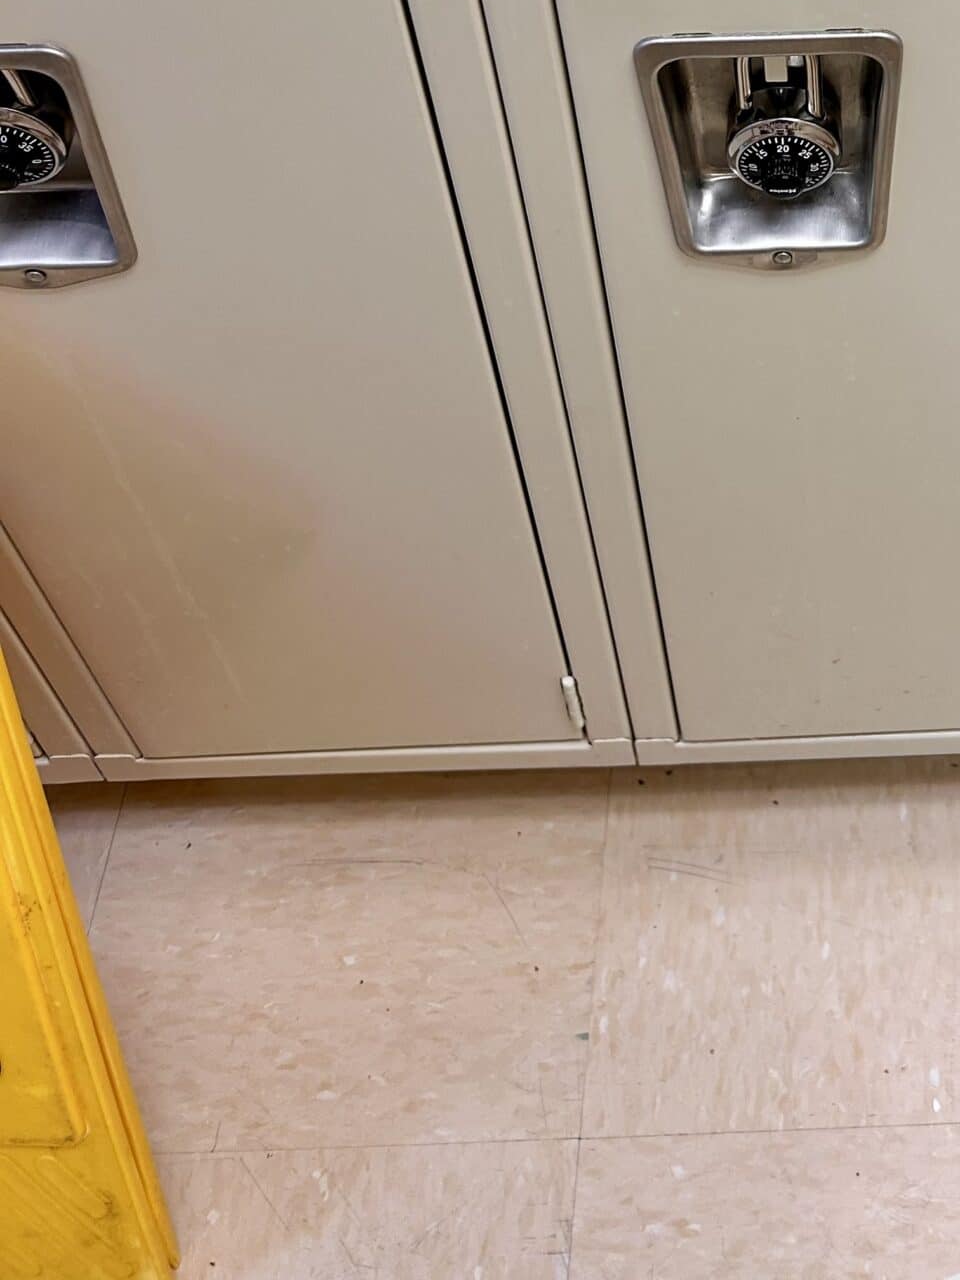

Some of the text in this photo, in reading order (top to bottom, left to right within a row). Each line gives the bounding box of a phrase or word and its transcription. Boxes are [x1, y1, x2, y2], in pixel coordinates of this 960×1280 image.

[17, 141, 34, 153] 35
[776, 145, 790, 153] 20
[755, 149, 768, 159] 15
[798, 149, 813, 159] 25
